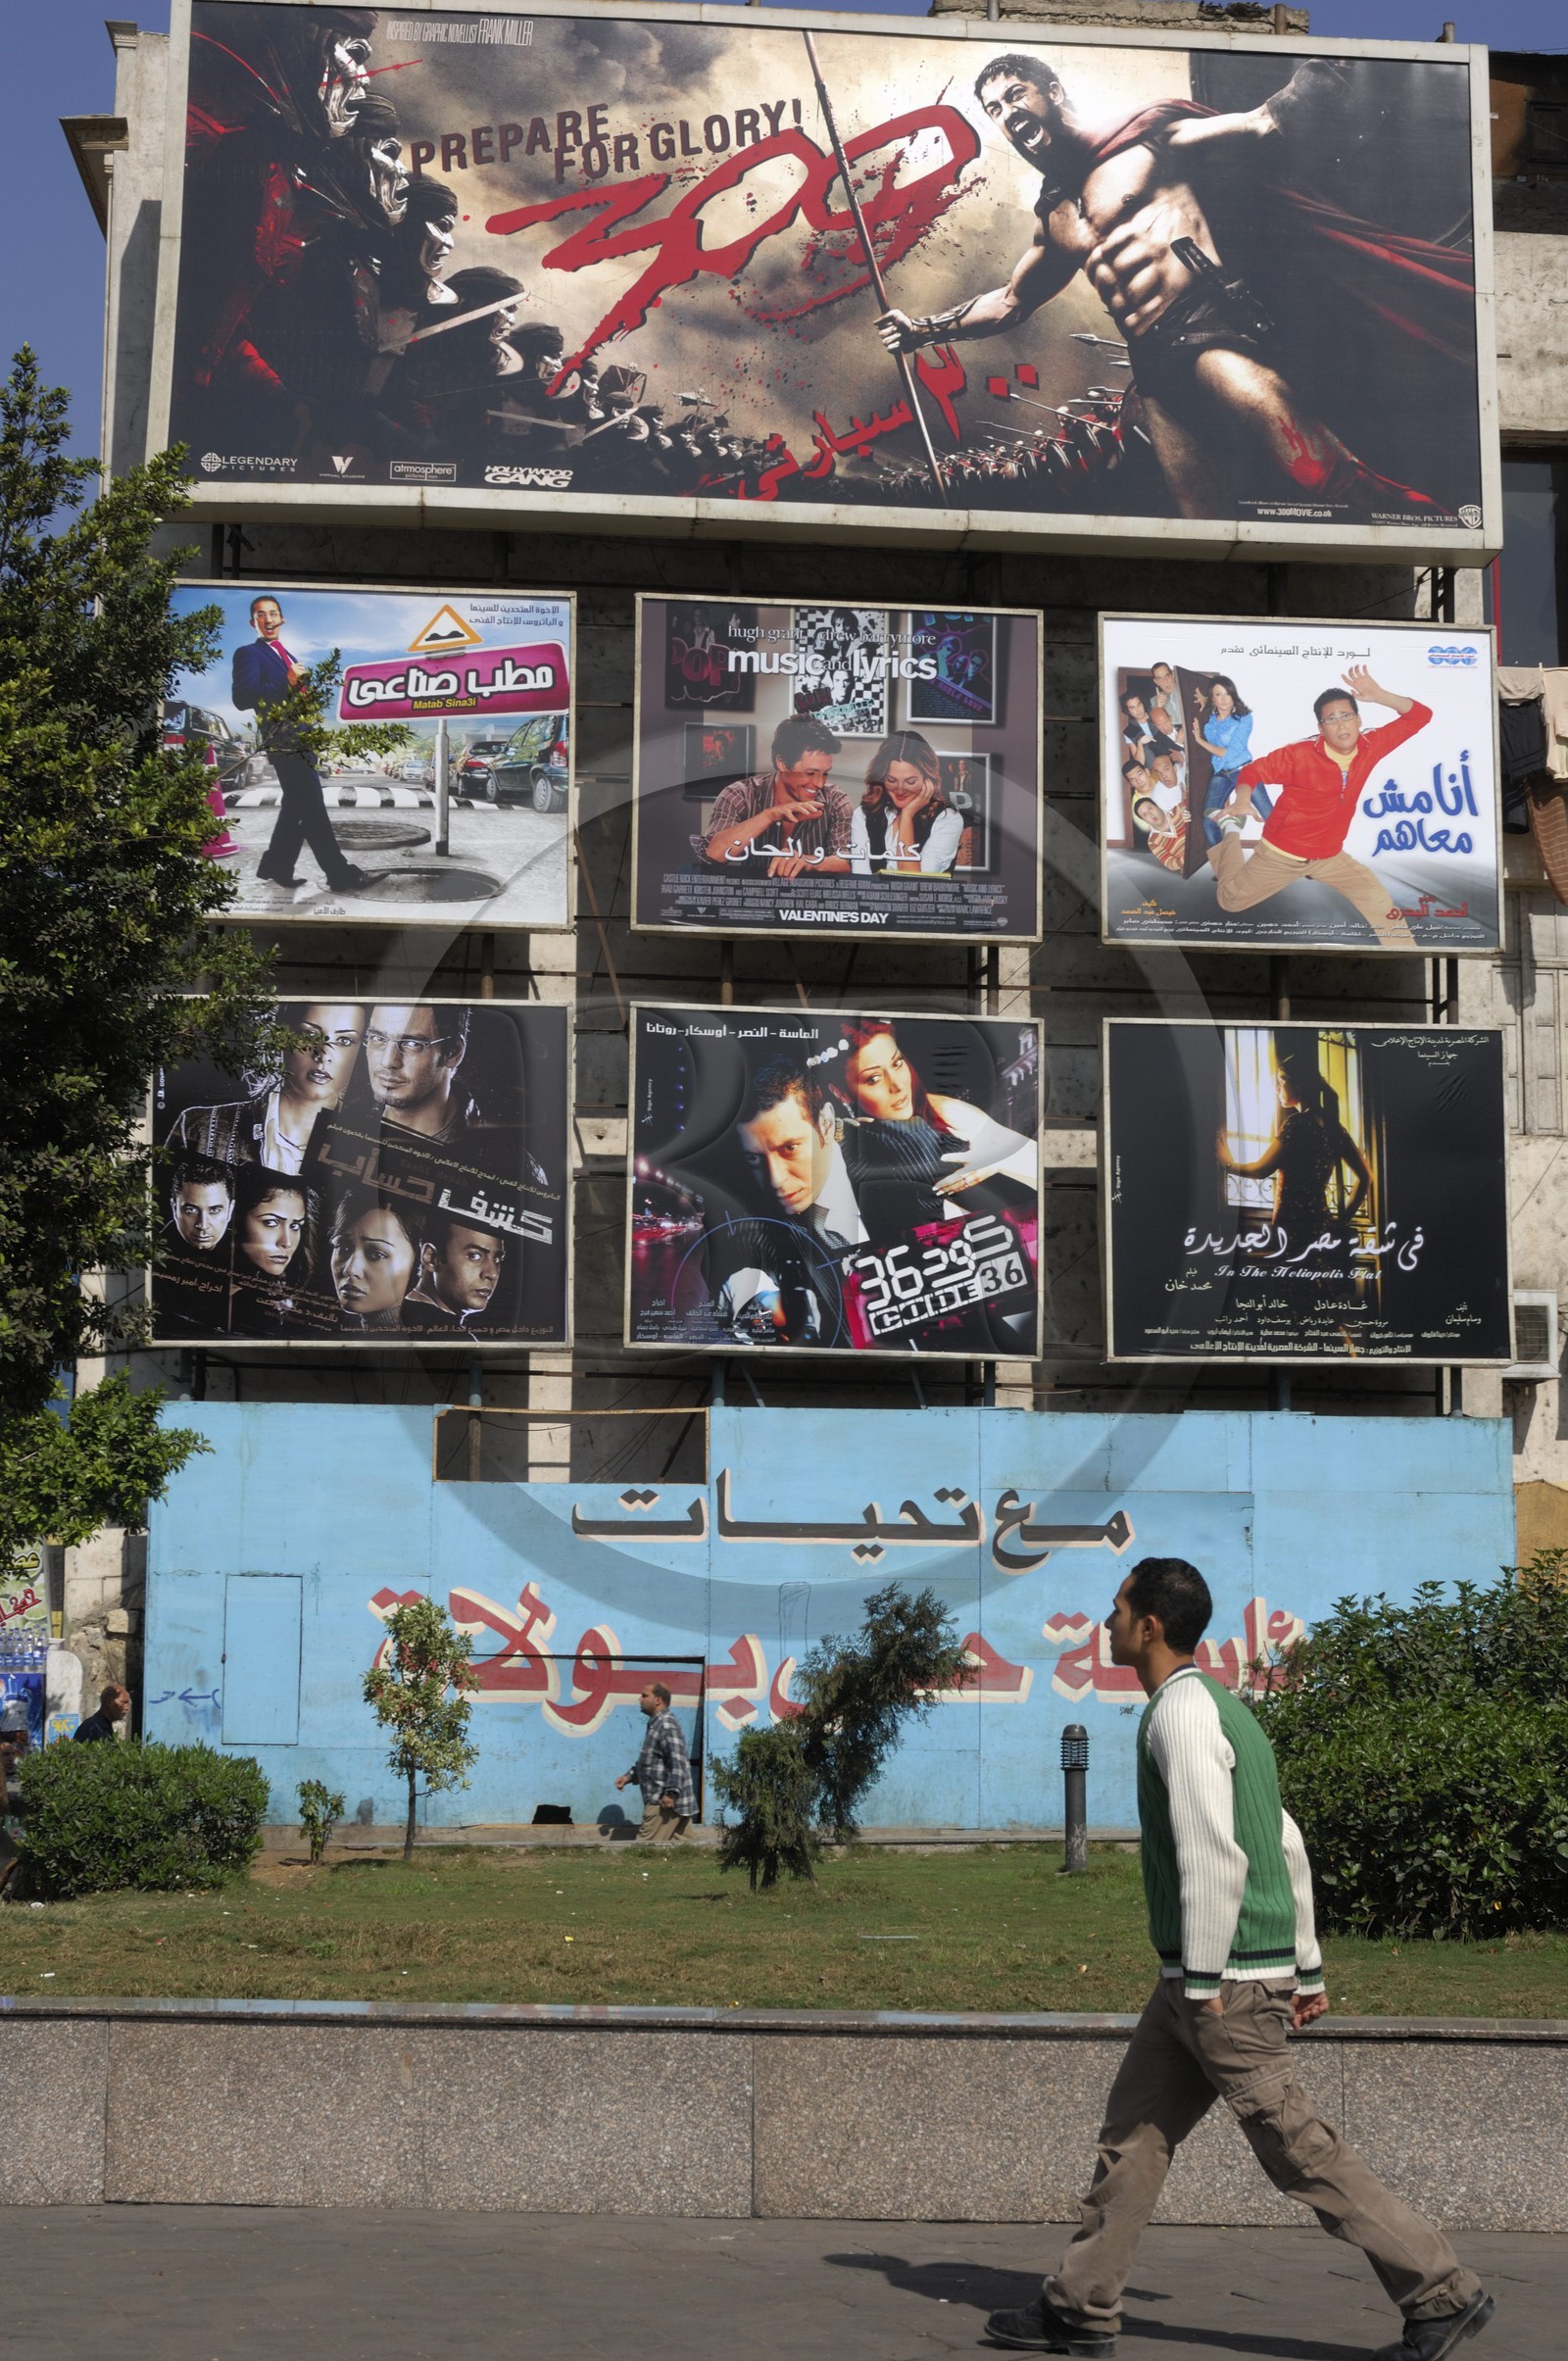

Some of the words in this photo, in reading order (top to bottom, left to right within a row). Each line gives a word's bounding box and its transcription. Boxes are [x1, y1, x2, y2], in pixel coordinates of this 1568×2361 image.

[414, 22, 422, 41] BY
[422, 23, 448, 42] GRAPHIC
[477, 18, 506, 45] FRANK
[504, 19, 534, 46] MILLER
[409, 102, 610, 180] PREPARE
[553, 130, 640, 184] FOR
[648, 96, 803, 163] GLORY!
[485, 103, 982, 397] 300
[221, 456, 298, 467] LEGENDARY
[394, 464, 454, 479] atmosphere
[485, 466, 573, 477] HOLLYWOOD
[484, 472, 571, 488] GANG
[1256, 508, 1333, 517] www.300MOVIE.co.uk
[727, 625, 764, 643] hugh
[767, 629, 806, 644] grant
[819, 630, 857, 643] drew
[858, 632, 937, 648] barrymore
[727, 646, 826, 676] music
[823, 656, 853, 671] and
[853, 649, 938, 684] lyrics
[466, 659, 555, 699] مطب
[412, 698, 443, 710] Matab
[445, 697, 476, 708] Sina3i
[1433, 749, 1479, 816] أنا
[1362, 778, 1434, 819] مش
[1372, 817, 1473, 858] معاهم
[836, 839, 922, 861] كلمات
[779, 909, 859, 923] VALENTINE'S
[859, 912, 889, 924] DAY
[646, 1021, 677, 1036] روتانا
[737, 1026, 767, 1039] النصر
[779, 1027, 819, 1039] الماسة
[1183, 1222, 1289, 1259] الجديدة
[1285, 1232, 1342, 1262] مصر
[1348, 1221, 1398, 1258] شقة
[979, 1255, 1026, 1295] 36
[1214, 1264, 1235, 1278] In
[1240, 1264, 1267, 1278] The
[1272, 1265, 1345, 1280] Heliopolis
[1348, 1266, 1383, 1280] Flat
[1164, 1279, 1188, 1292] خان
[1190, 1281, 1212, 1292] محمد
[1268, 1299, 1289, 1309] خالد
[1313, 1300, 1338, 1311] عادل
[570, 1467, 987, 1566] تحيات
[992, 1488, 1137, 1577] مع
